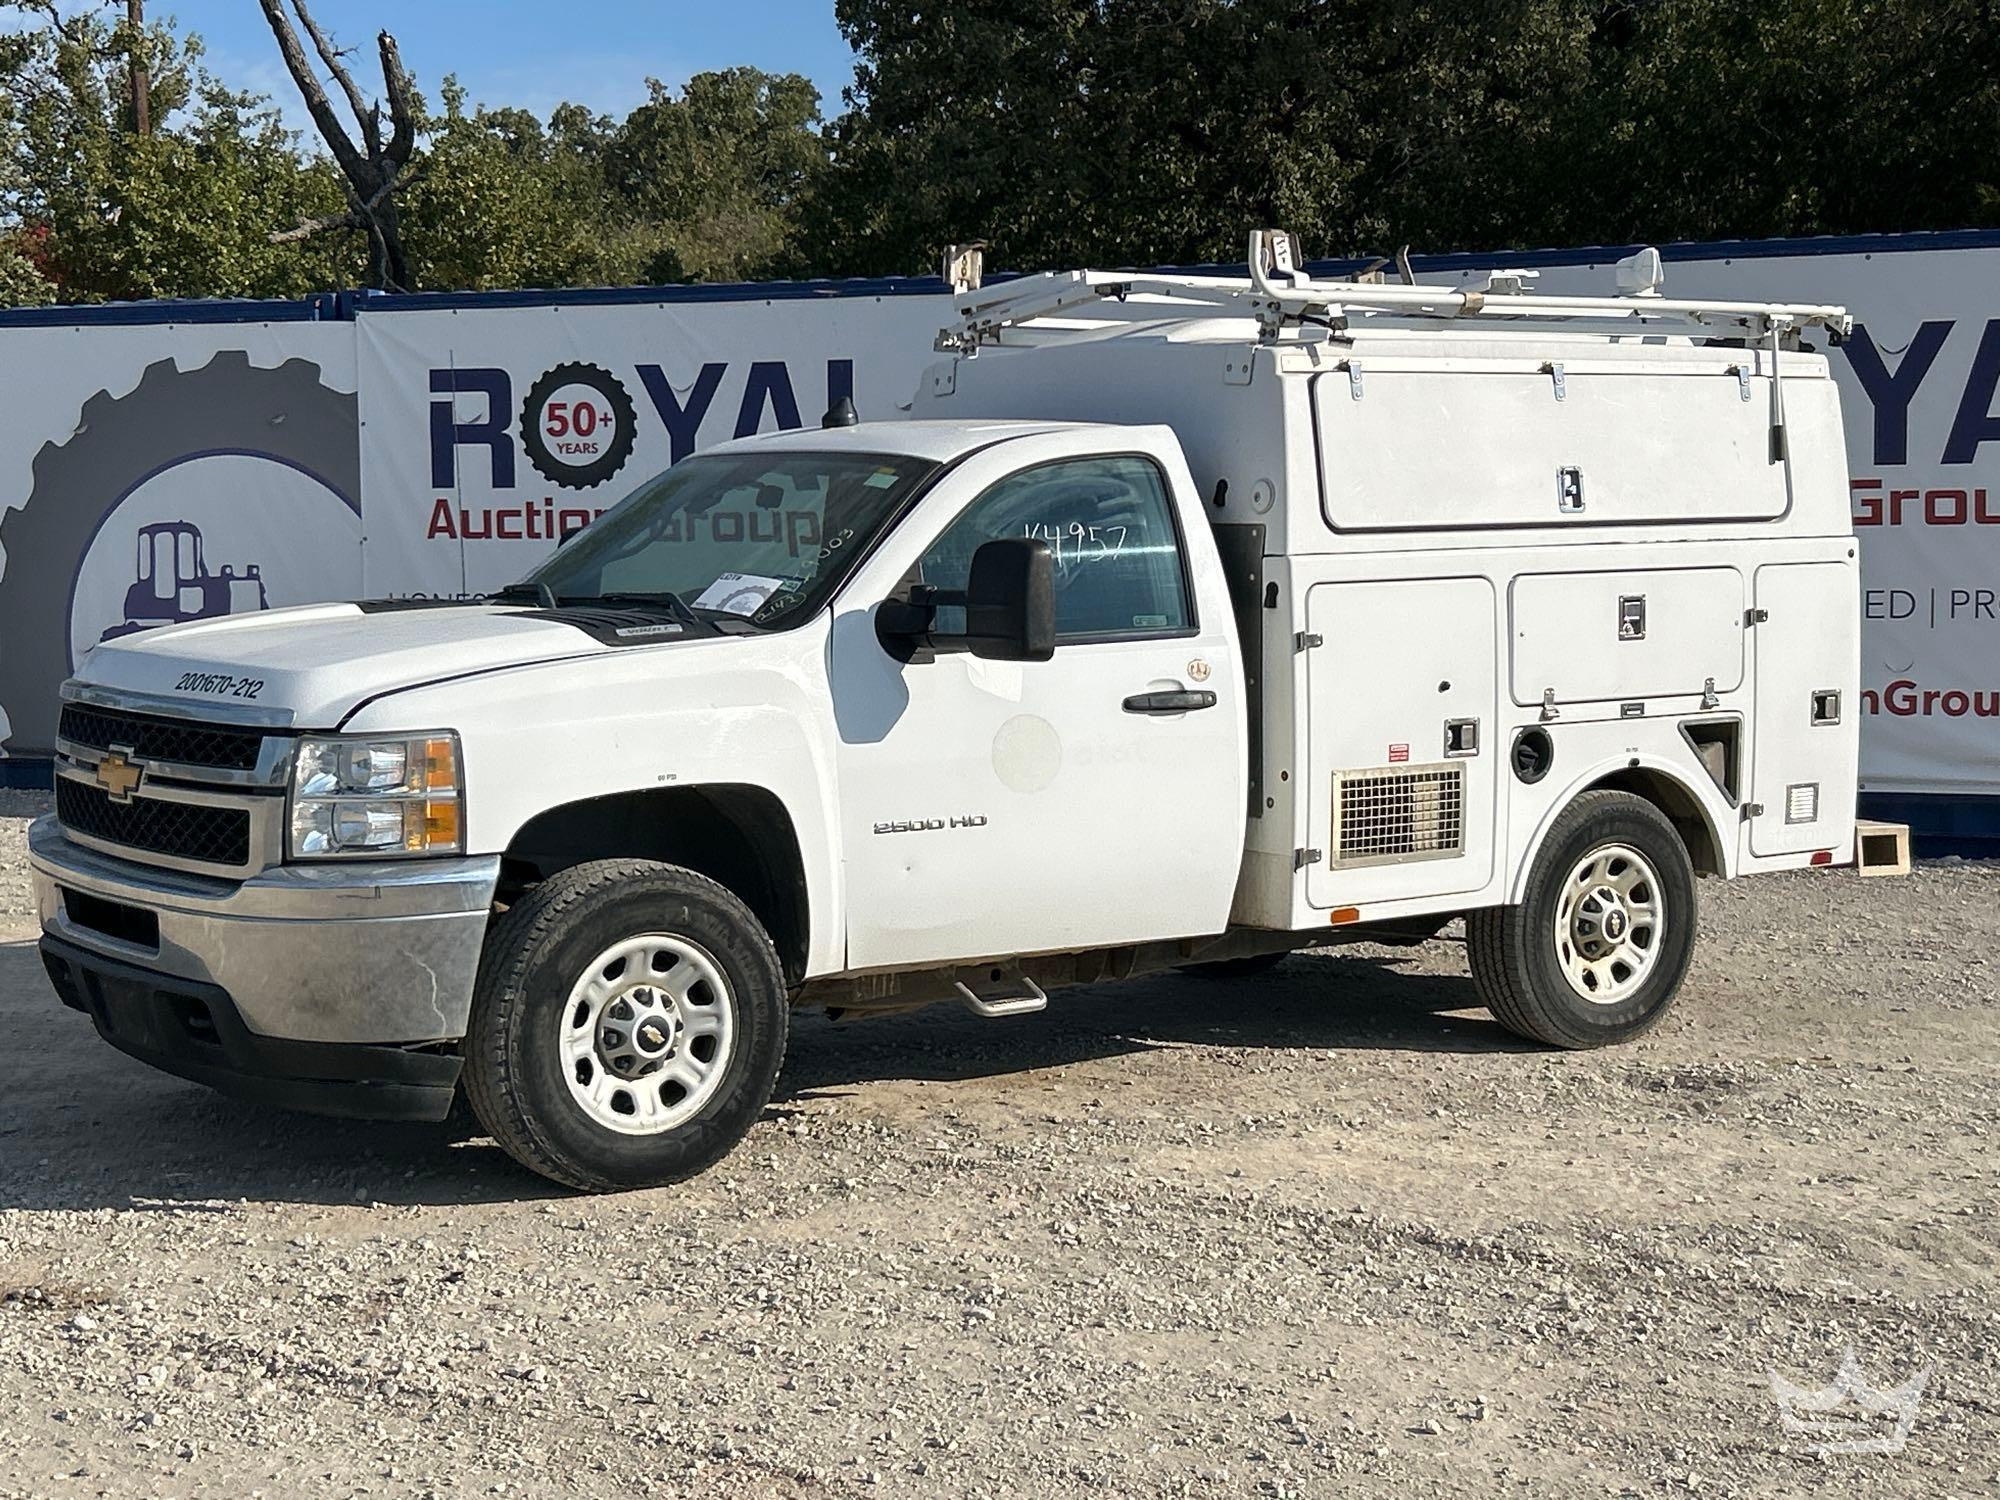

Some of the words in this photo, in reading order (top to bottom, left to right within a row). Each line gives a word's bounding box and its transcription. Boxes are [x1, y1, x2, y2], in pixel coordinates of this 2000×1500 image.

[546, 401, 612, 437] 50+
[557, 442, 598, 454] YEARS
[427, 496, 609, 539] Auctio
[1951, 589, 2000, 619] PR
[175, 672, 264, 699] 2001670-212
[873, 819, 945, 834] 2500
[949, 815, 988, 828] HD
